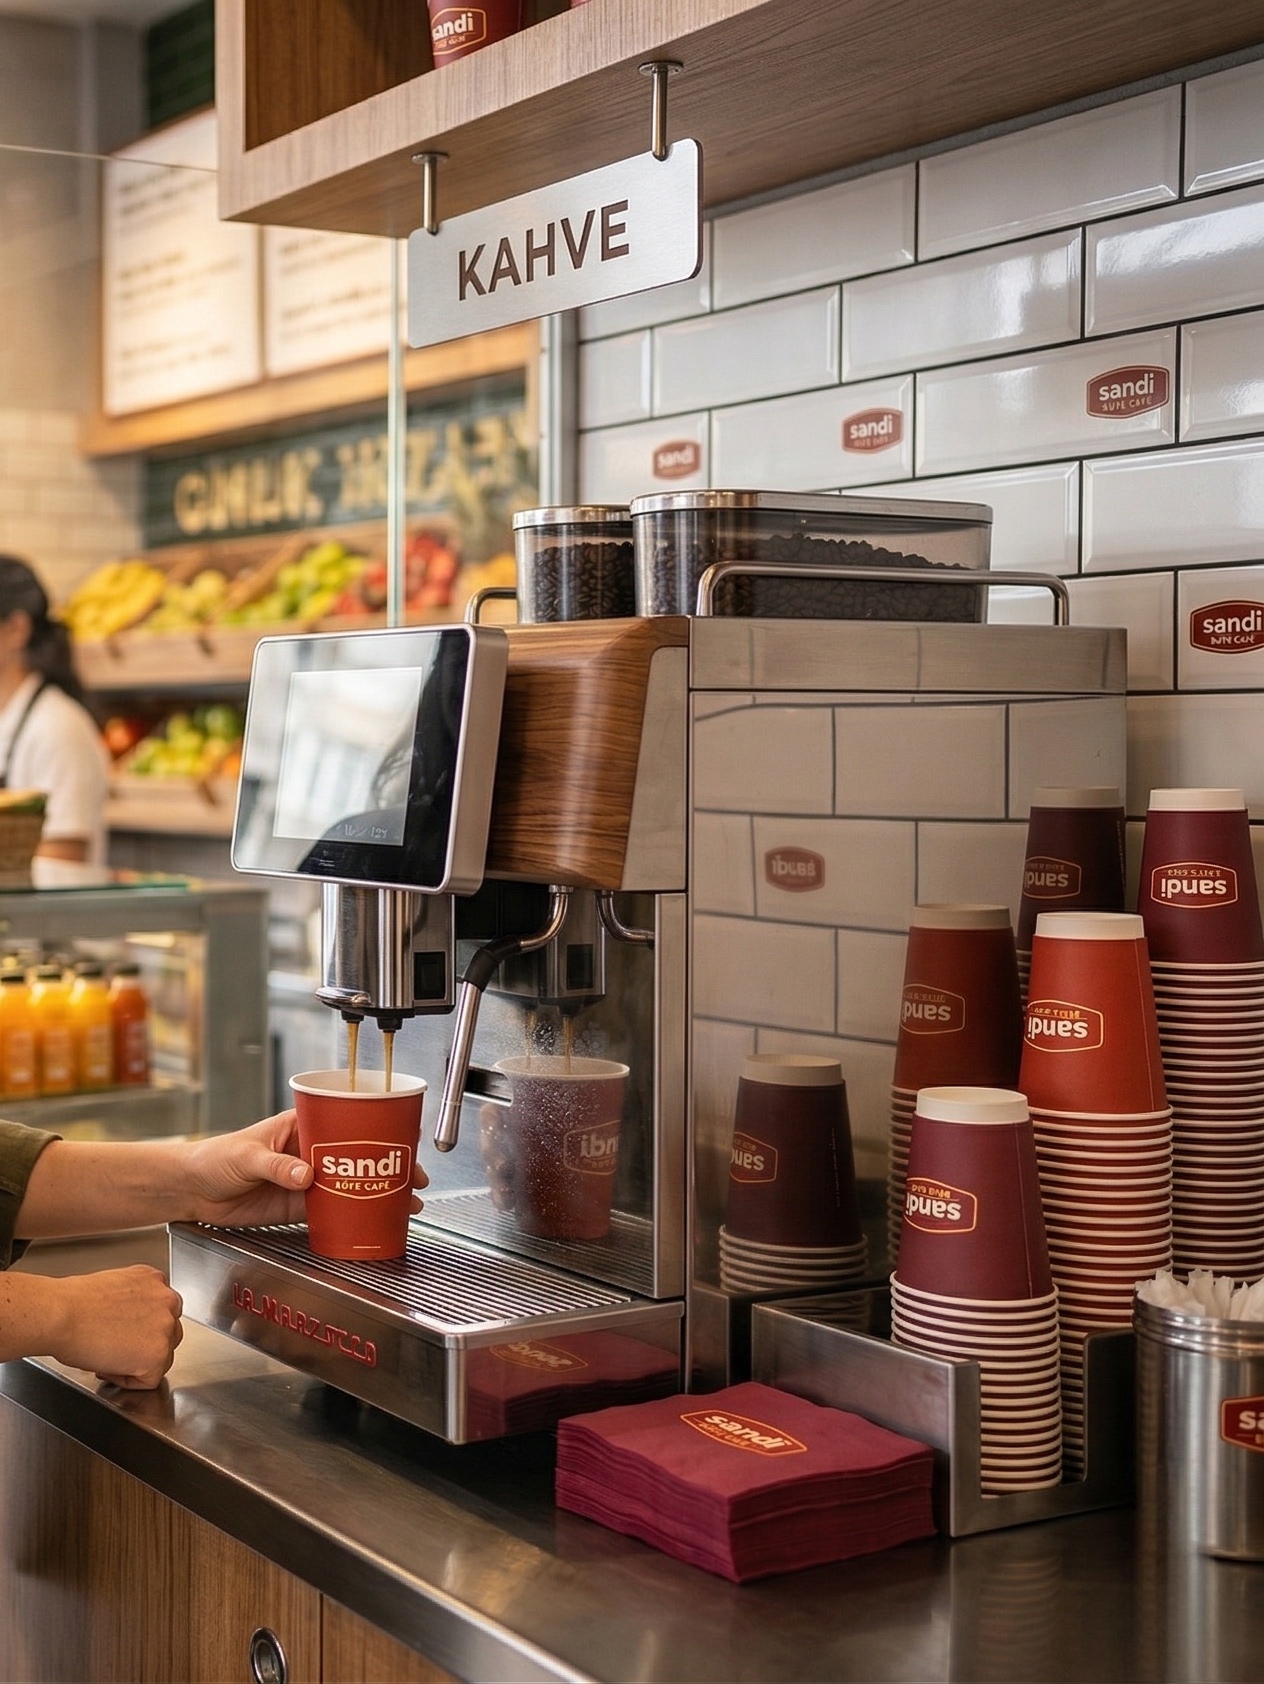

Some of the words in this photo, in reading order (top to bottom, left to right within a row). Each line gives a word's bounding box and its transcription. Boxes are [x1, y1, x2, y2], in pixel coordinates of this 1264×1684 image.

[432, 12, 474, 41] andi
[459, 199, 630, 301] KAHVE
[1099, 372, 1154, 401] sandi
[850, 414, 893, 439] sandi
[1203, 610, 1262, 634] sandi
[1161, 878, 1227, 899] sandi
[1028, 1017, 1088, 1040] sandi
[322, 1150, 402, 1177] sandi
[906, 1193, 961, 1220] sandi
[705, 1415, 792, 1449] sandi
